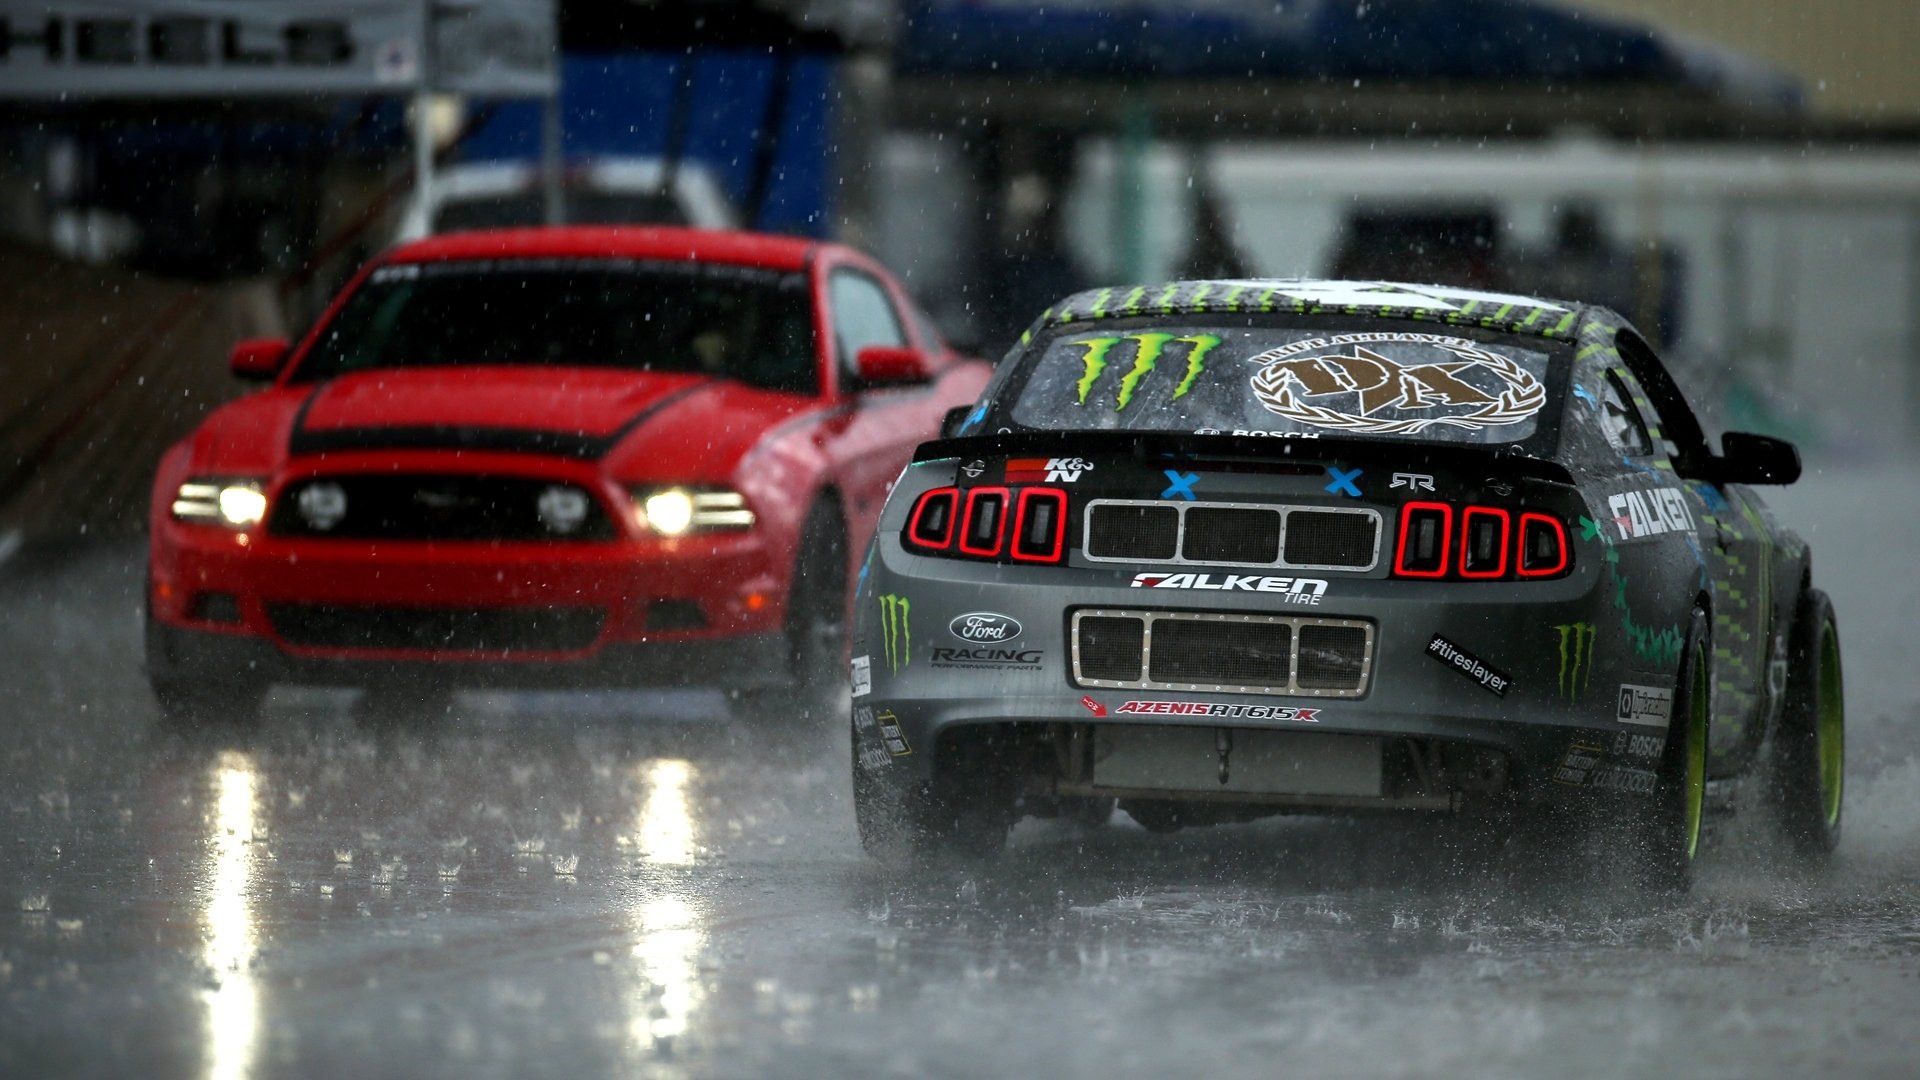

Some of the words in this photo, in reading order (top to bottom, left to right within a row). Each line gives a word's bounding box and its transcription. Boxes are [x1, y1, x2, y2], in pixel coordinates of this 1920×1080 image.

[1608, 487, 1697, 540] FALKEN
[1130, 573, 1329, 595] FALKEN
[1284, 592, 1322, 605] TIRE
[962, 616, 1006, 639] Ford
[931, 647, 1044, 663] RACING
[931, 662, 1004, 670] PERFORMANCE
[1428, 637, 1508, 692] #tireslayer
[1628, 734, 1665, 758] BOSCH
